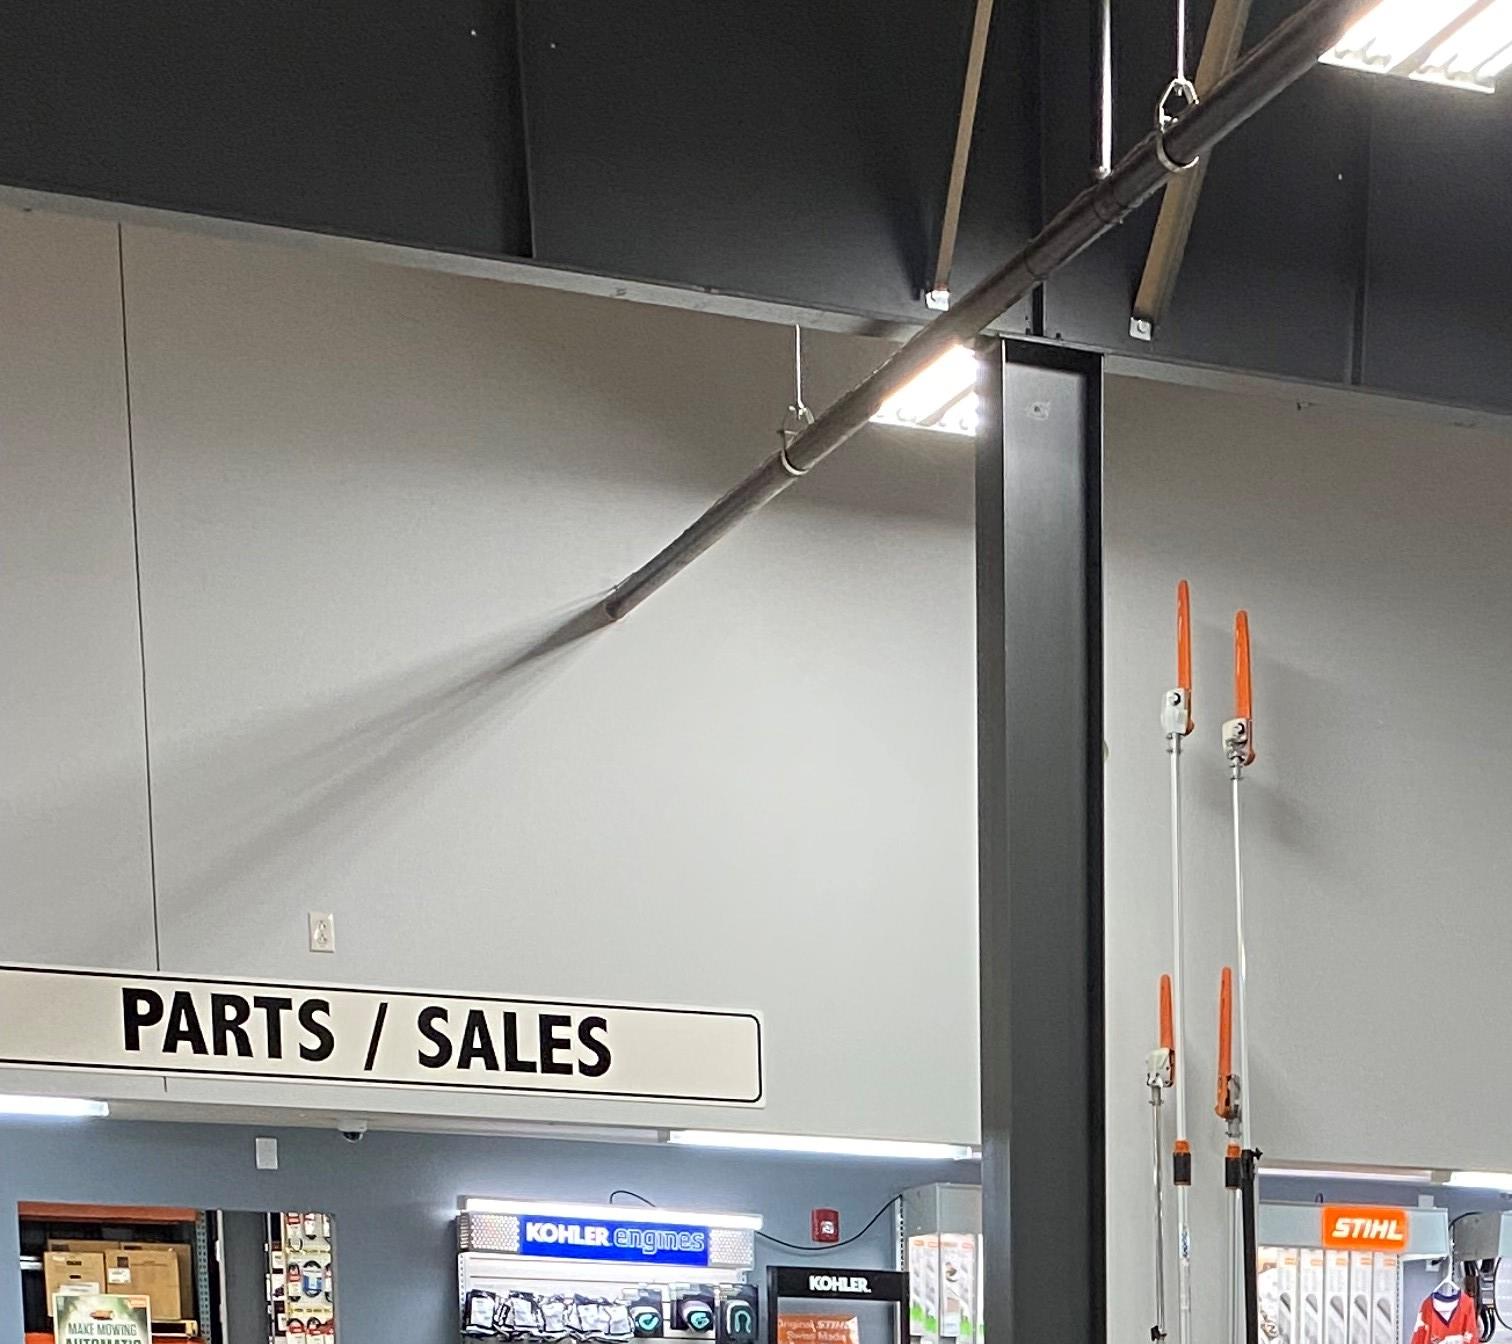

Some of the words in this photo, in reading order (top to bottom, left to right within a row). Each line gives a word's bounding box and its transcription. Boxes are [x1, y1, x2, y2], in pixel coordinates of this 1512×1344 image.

[121, 986, 333, 1063] PARTS
[363, 1001, 389, 1072] /
[416, 1005, 612, 1077] SALES
[525, 1220, 610, 1248] KOHLER
[613, 1226, 706, 1257] engines
[1331, 1217, 1404, 1242] STIHL
[809, 1274, 872, 1294] KOHLER
[67, 1322, 96, 1336] MAKE
[96, 1323, 138, 1337] MOWING
